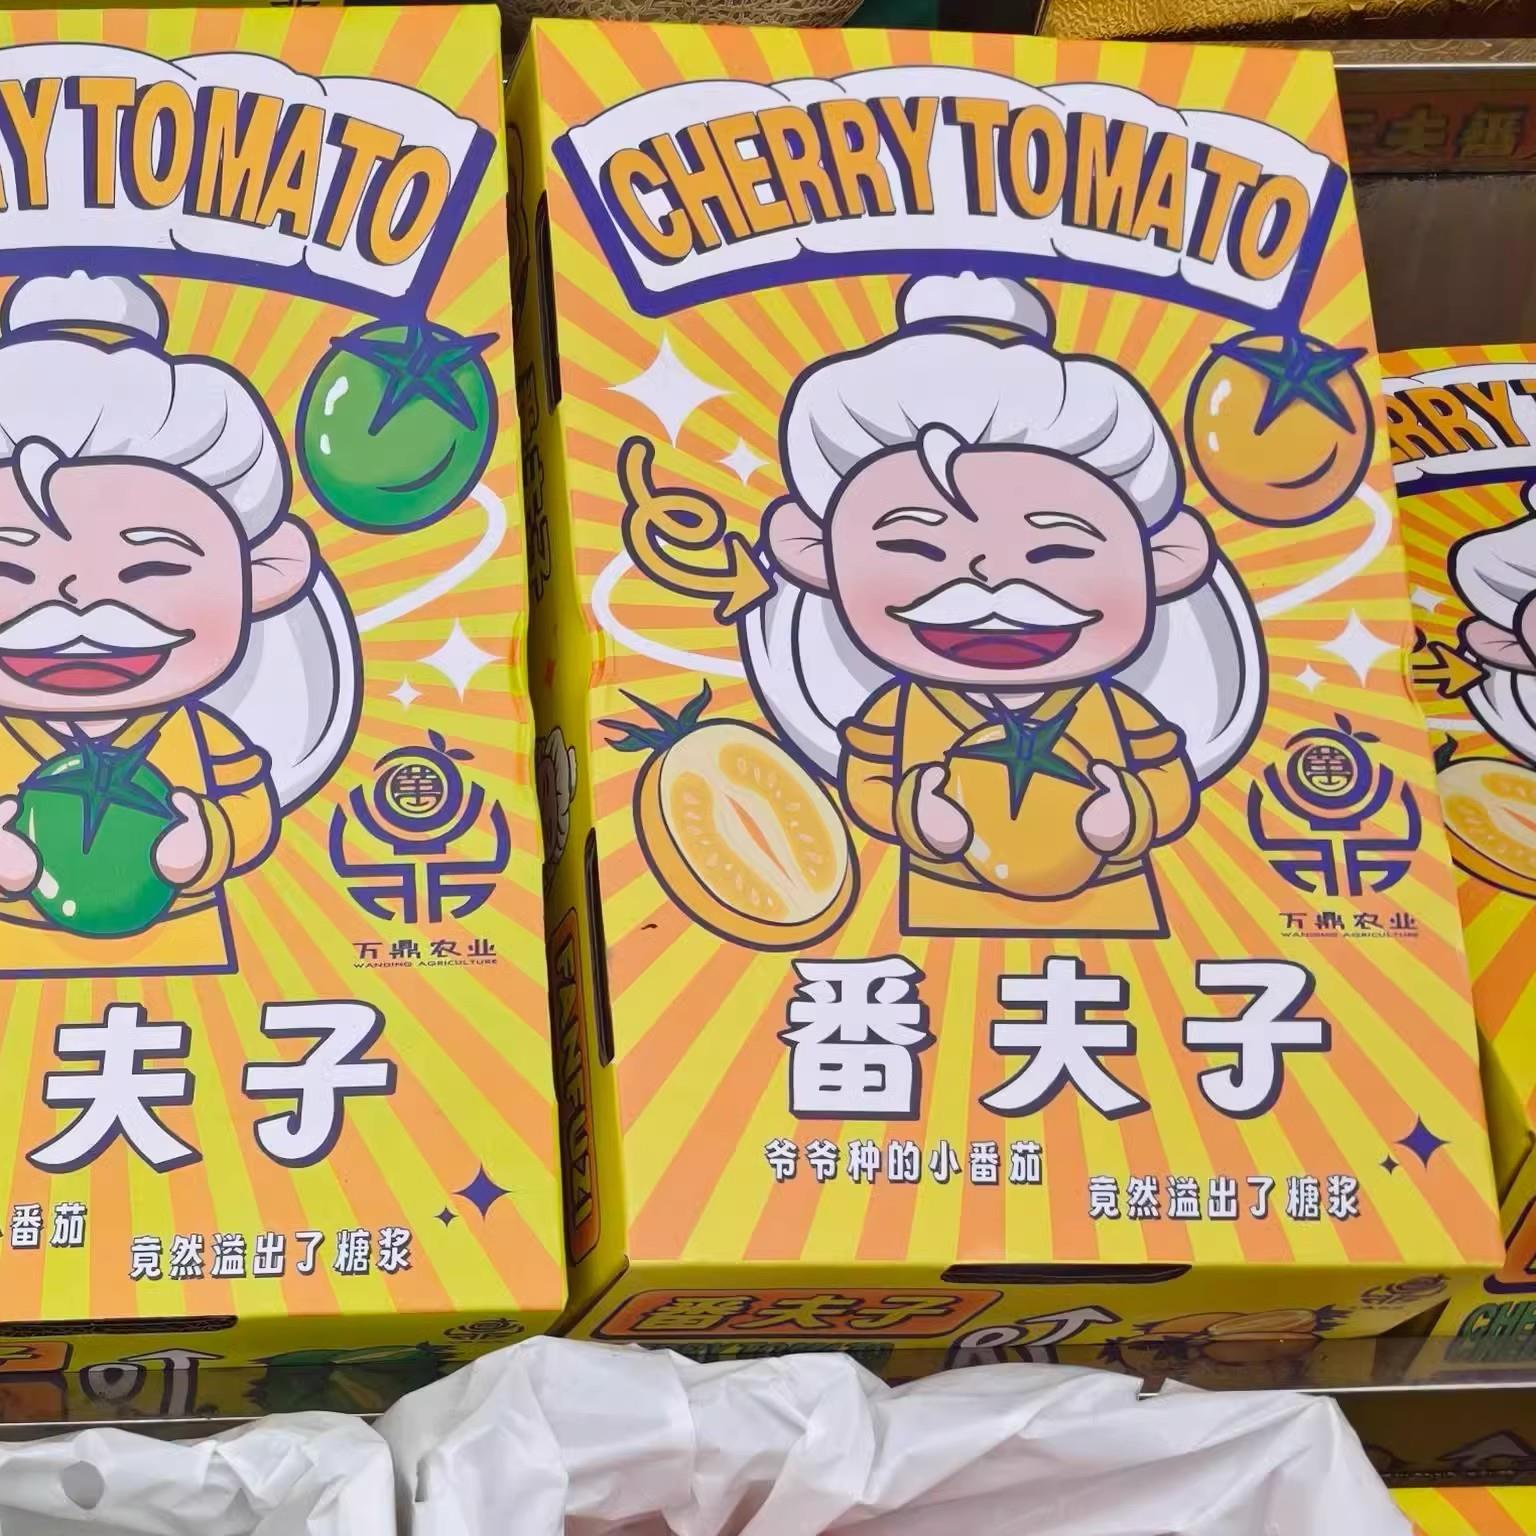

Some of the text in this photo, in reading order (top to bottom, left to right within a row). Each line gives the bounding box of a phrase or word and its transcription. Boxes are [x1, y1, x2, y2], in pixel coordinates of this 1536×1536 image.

[64, 75, 452, 267] TOMATO
[599, 96, 1314, 282] CHERRY TOMATO
[1385, 380, 1531, 465] RRY
[1279, 911, 1418, 930] 万鼎农业
[352, 939, 497, 960] 万鼎农业
[777, 953, 1332, 1121] 番夫子
[764, 1138, 1044, 1187] 爷爷种的小番茄
[1087, 1175, 1362, 1222] 竟然溢出了糖浆
[128, 1227, 415, 1282] 竟然溢出了糖浆
[633, 1295, 958, 1330] 番夫子
